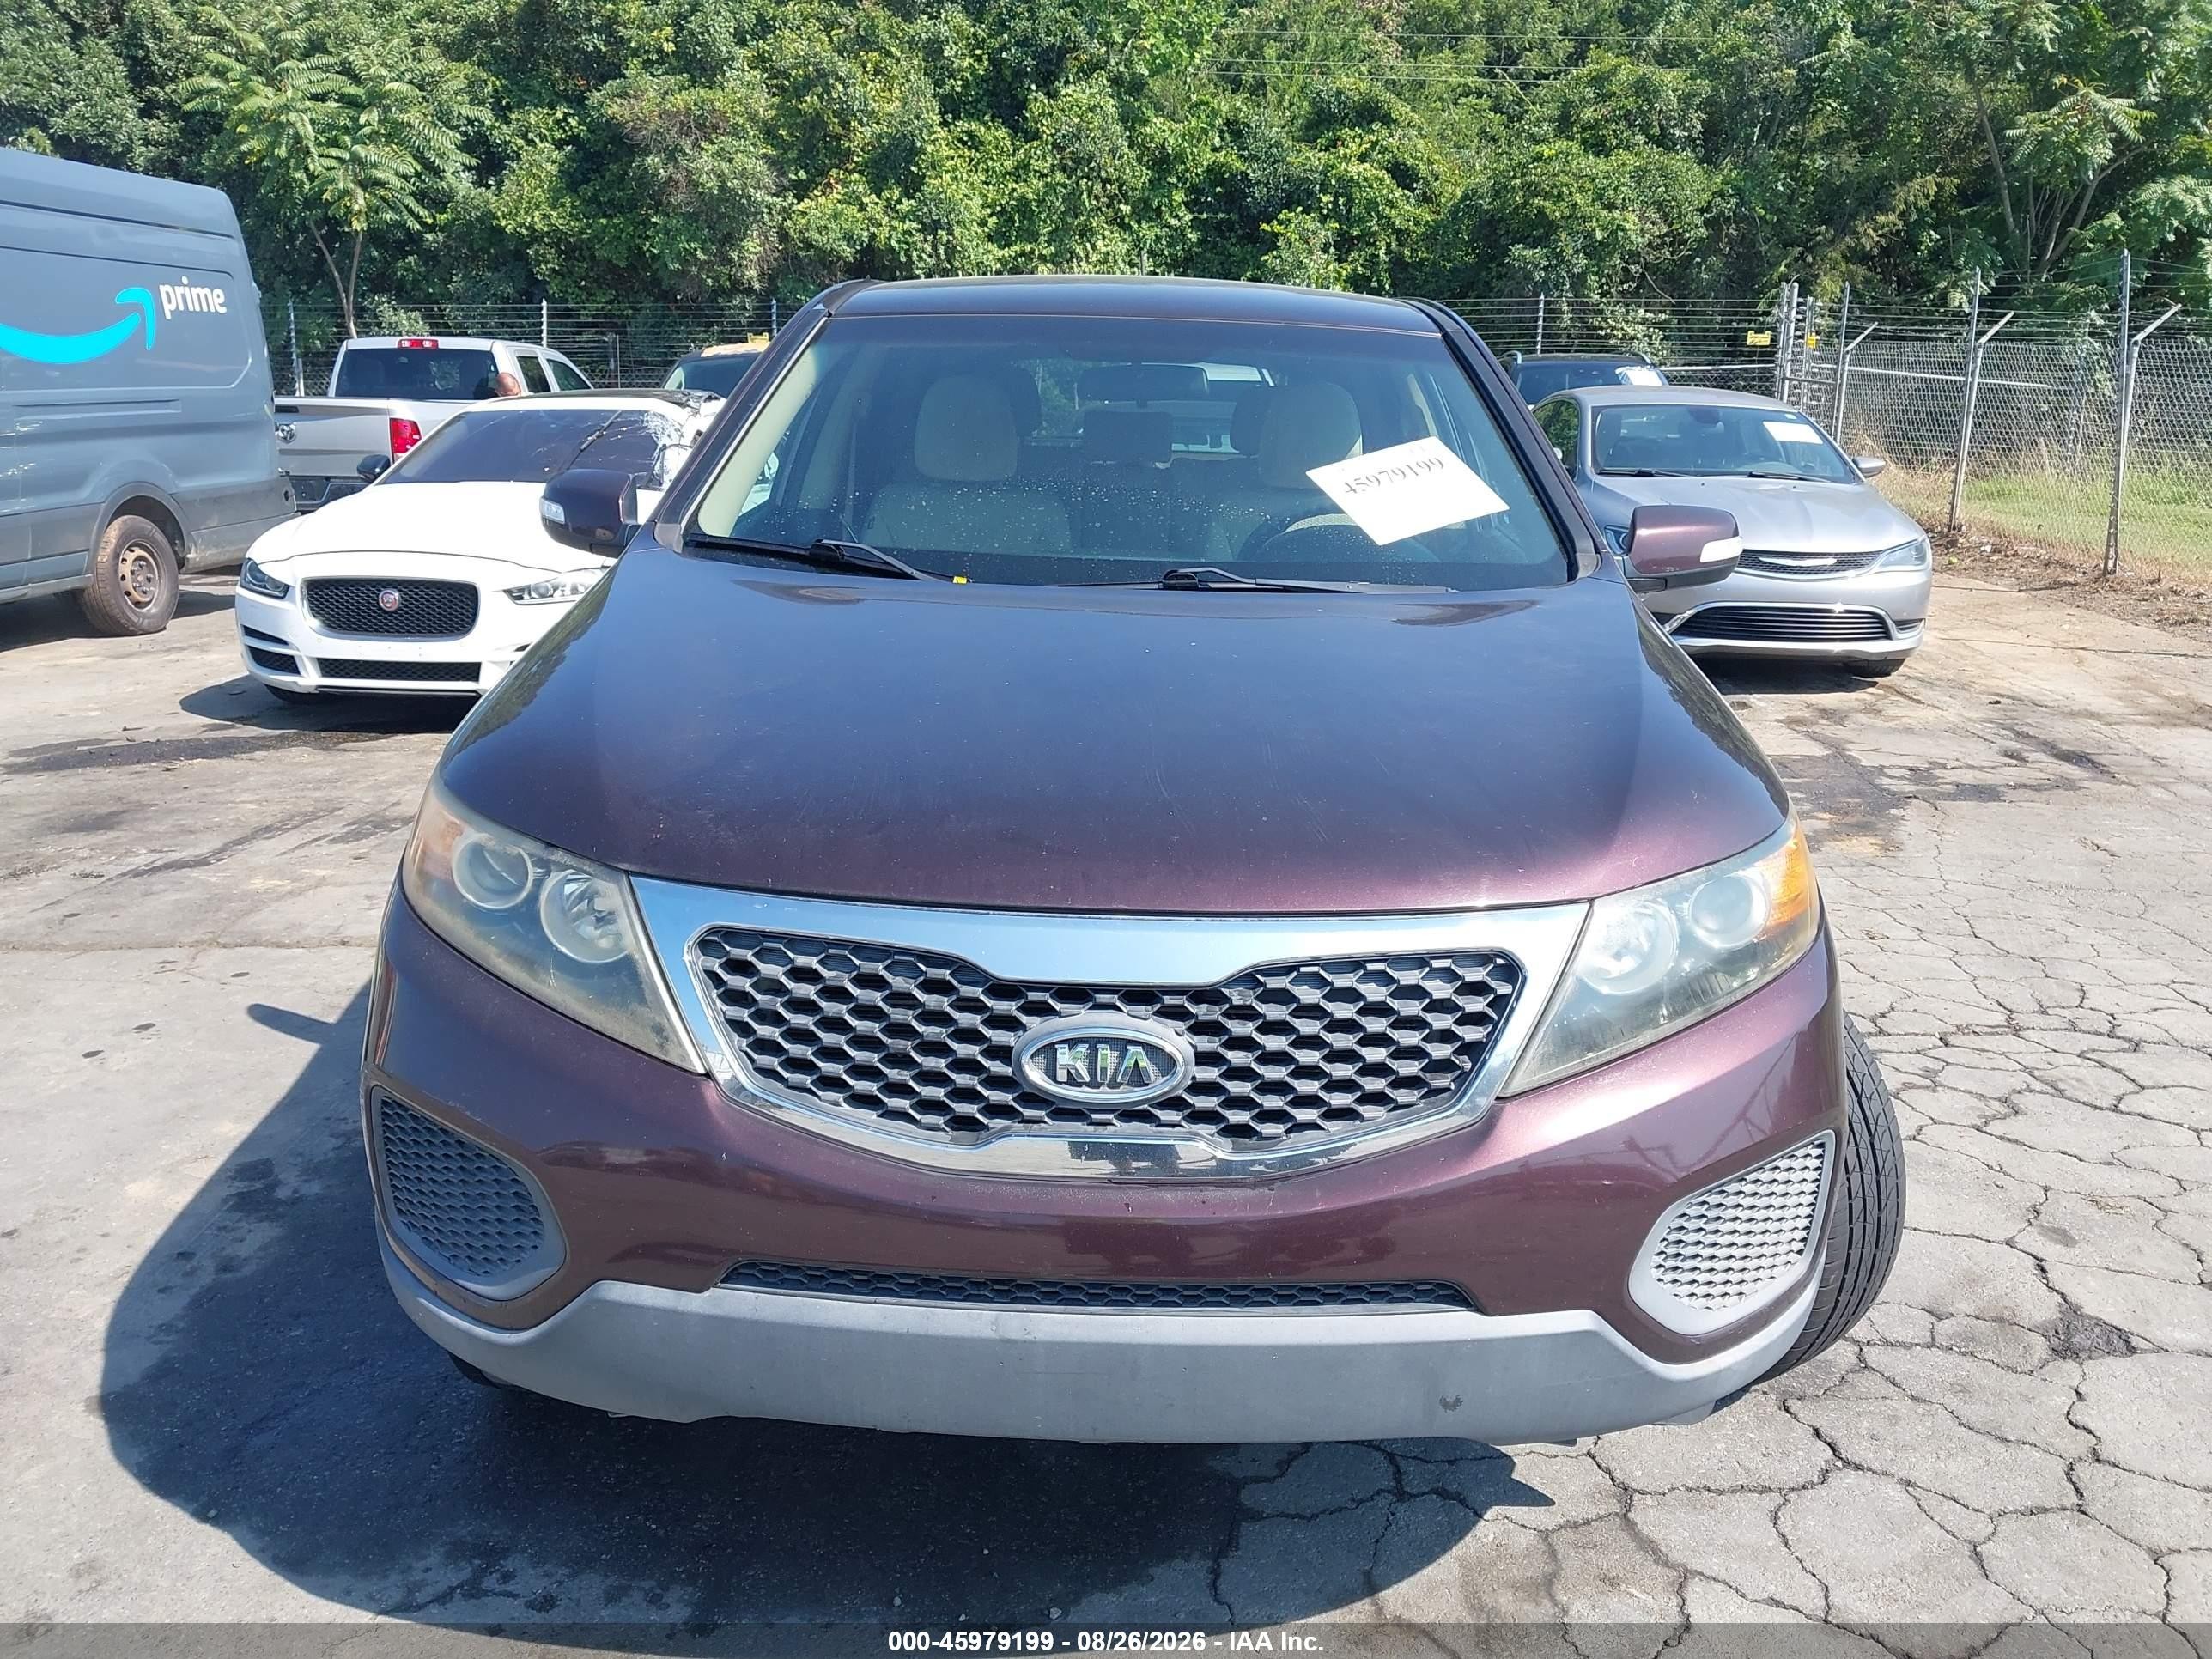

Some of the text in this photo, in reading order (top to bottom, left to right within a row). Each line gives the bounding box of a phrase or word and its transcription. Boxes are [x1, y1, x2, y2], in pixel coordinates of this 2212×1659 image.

[159, 276, 228, 319] prime
[1344, 457, 1444, 495] 45979199
[1054, 1043, 1154, 1084] KIA
